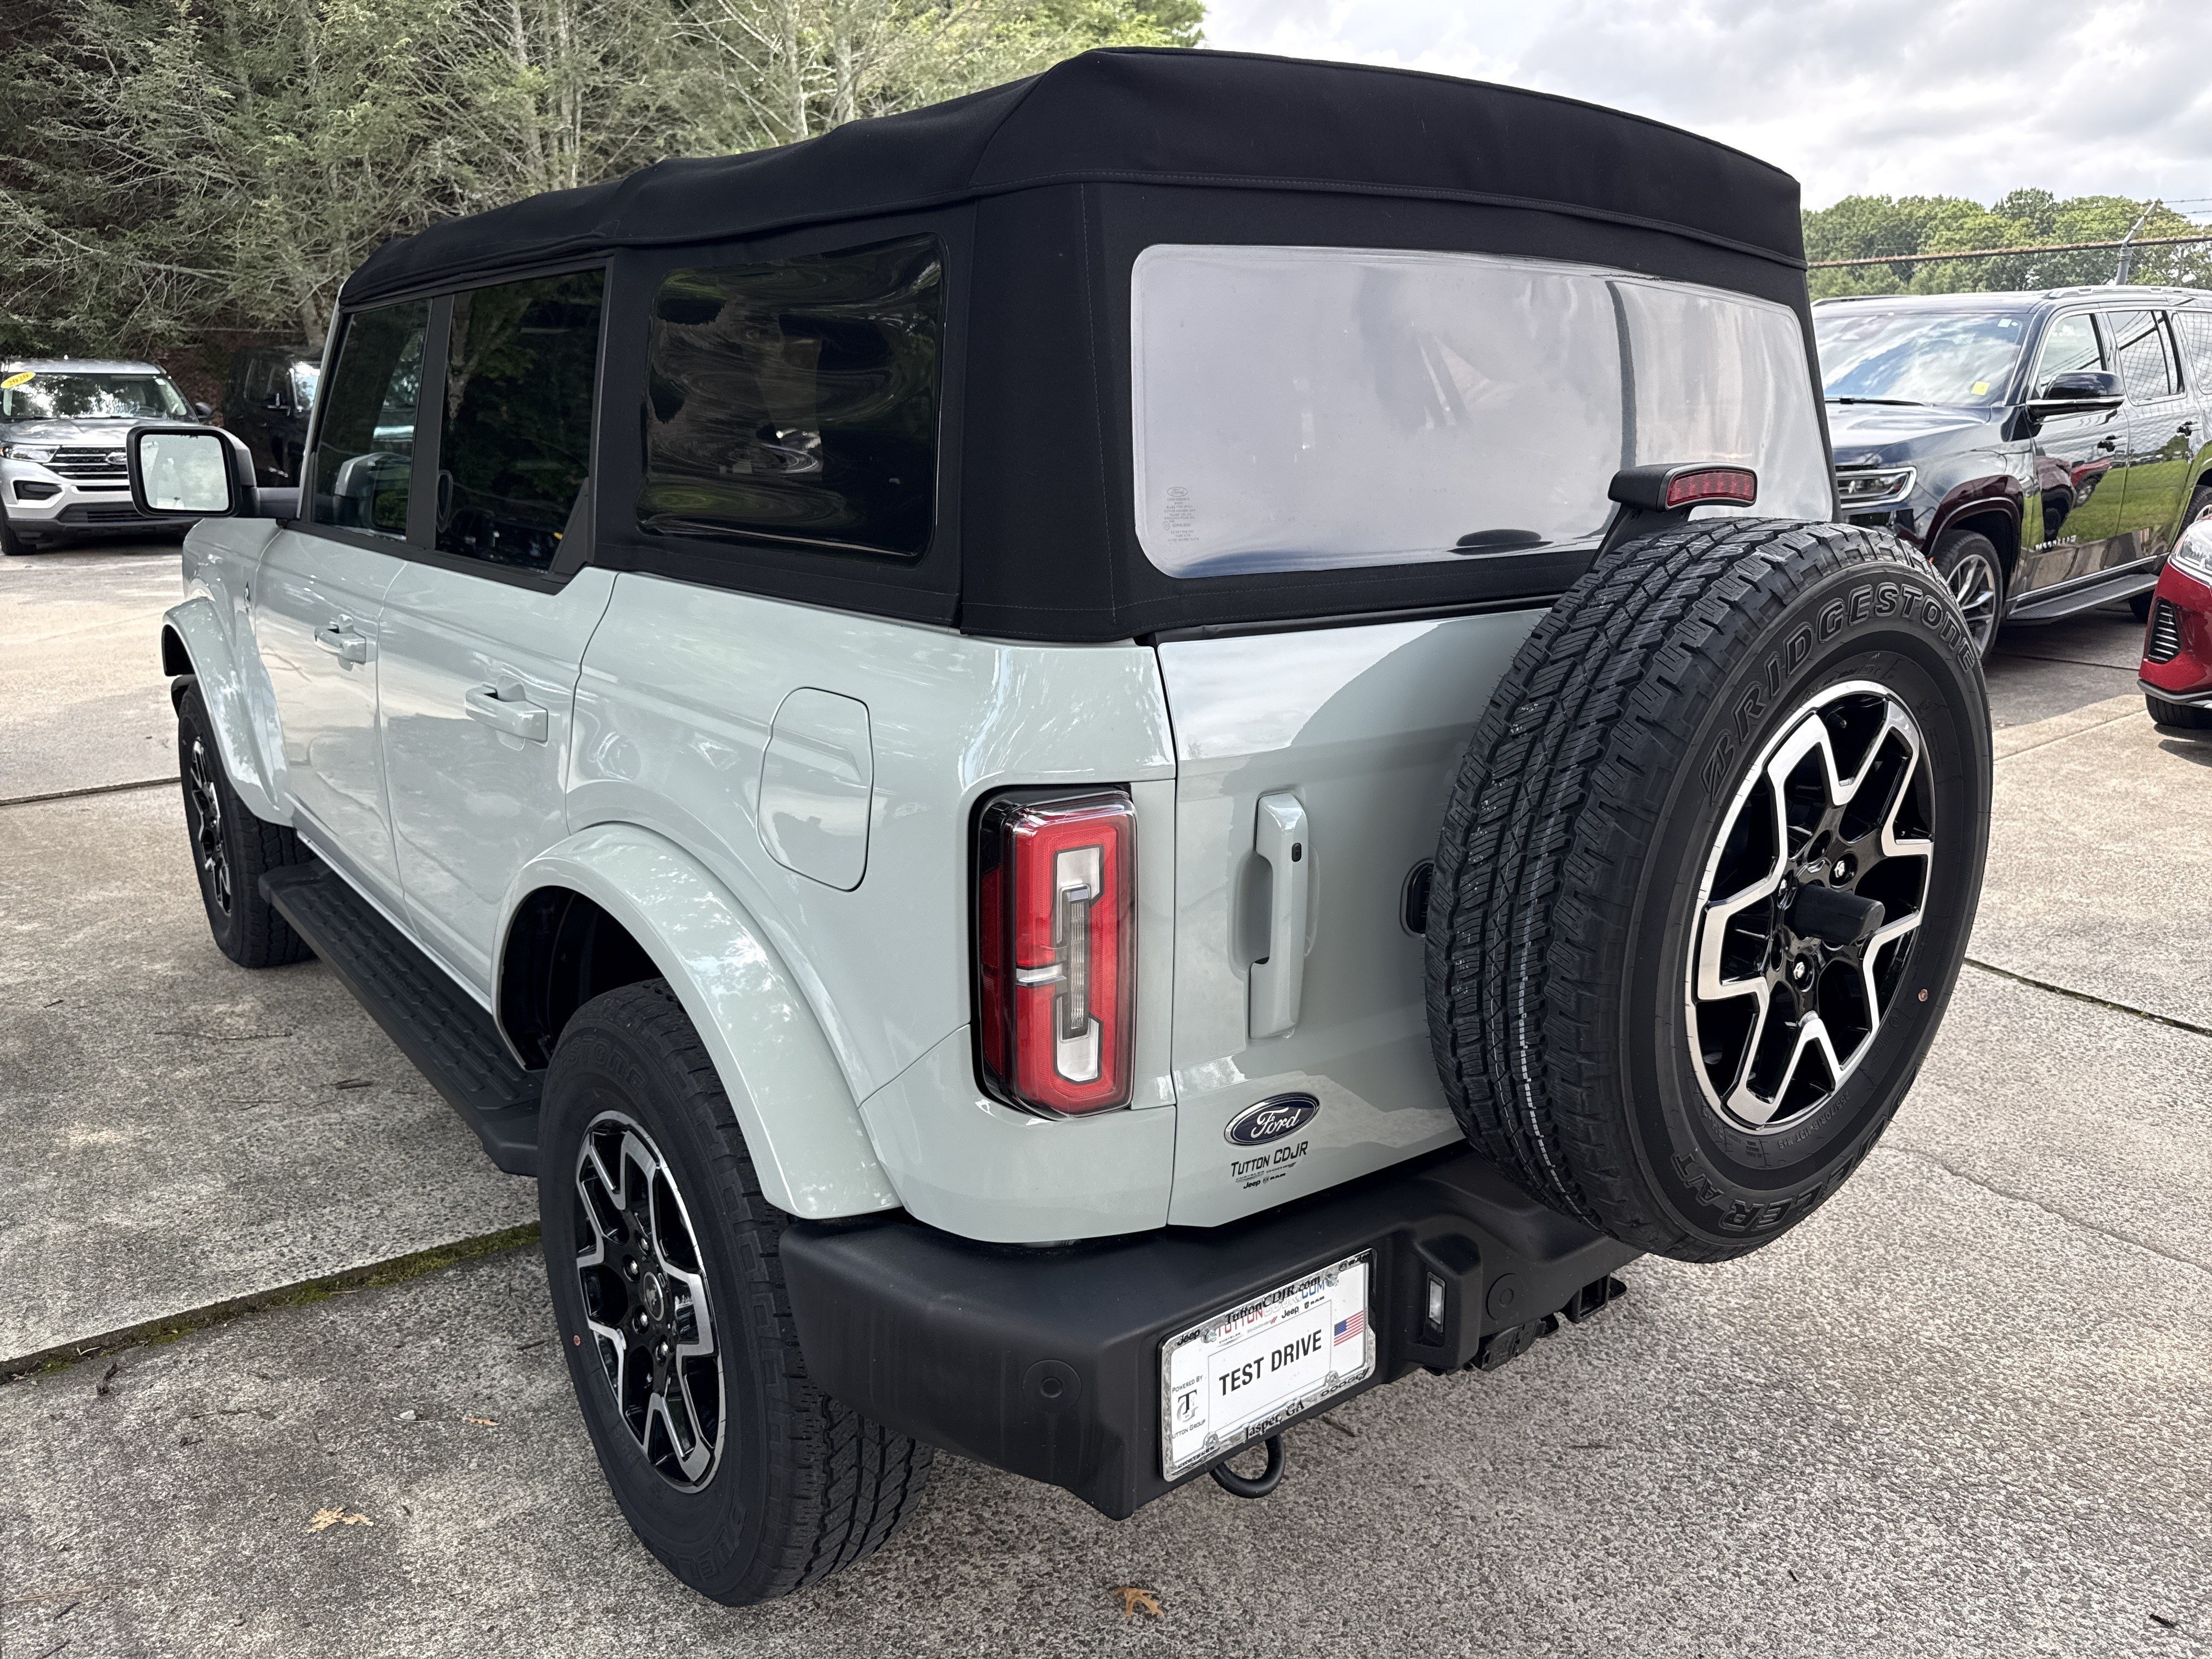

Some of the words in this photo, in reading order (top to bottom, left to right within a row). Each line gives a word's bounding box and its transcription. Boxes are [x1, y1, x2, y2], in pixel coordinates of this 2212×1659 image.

[8, 374, 29, 386] 2020
[1703, 583, 1976, 801] BRIDGESTONE
[1250, 1107, 1302, 1138] Ford
[1231, 1154, 1271, 1177] TUTTON
[1273, 1141, 1308, 1165] CDJR
[1243, 1180, 1261, 1189] Jeep
[1269, 1172, 1286, 1181] RAM
[1177, 1329, 1200, 1346] Jeep
[1225, 1276, 1321, 1324] TuttonCDJR.com
[1282, 1306, 1300, 1319] Jeep
[1219, 1357, 1264, 1396] TEST
[1271, 1329, 1322, 1372] DRIVE
[1172, 1379, 1195, 1393] POWERED
[1196, 1374, 1203, 1383] BY
[1172, 1427, 1189, 1439] UTTON
[1189, 1419, 1206, 1431] GROUP
[1244, 1413, 1283, 1441] Jasper,
[1285, 1398, 1305, 1417] GA
